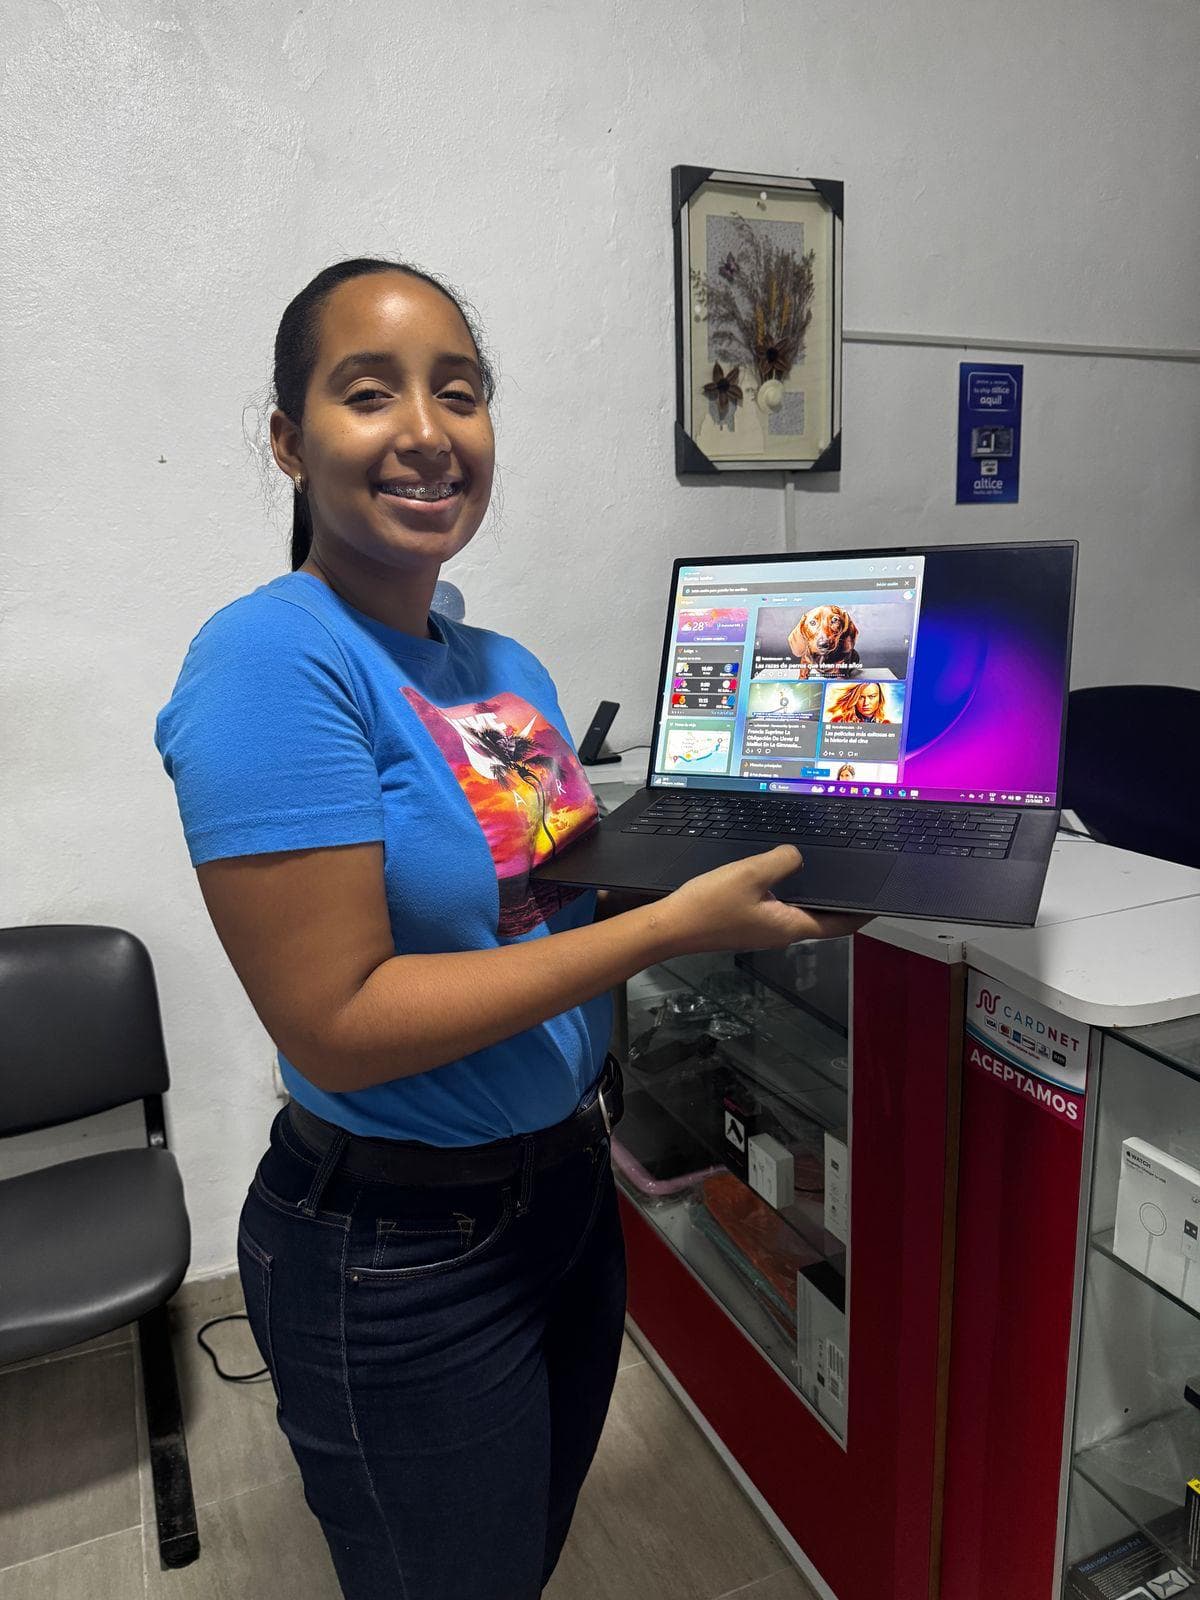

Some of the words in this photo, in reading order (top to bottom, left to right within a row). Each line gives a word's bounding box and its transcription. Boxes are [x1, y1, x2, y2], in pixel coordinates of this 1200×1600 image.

[974, 478, 1003, 489] altice
[1003, 1005, 1080, 1052] CARDNET
[970, 1048, 1078, 1121] ACEPTAMOS
